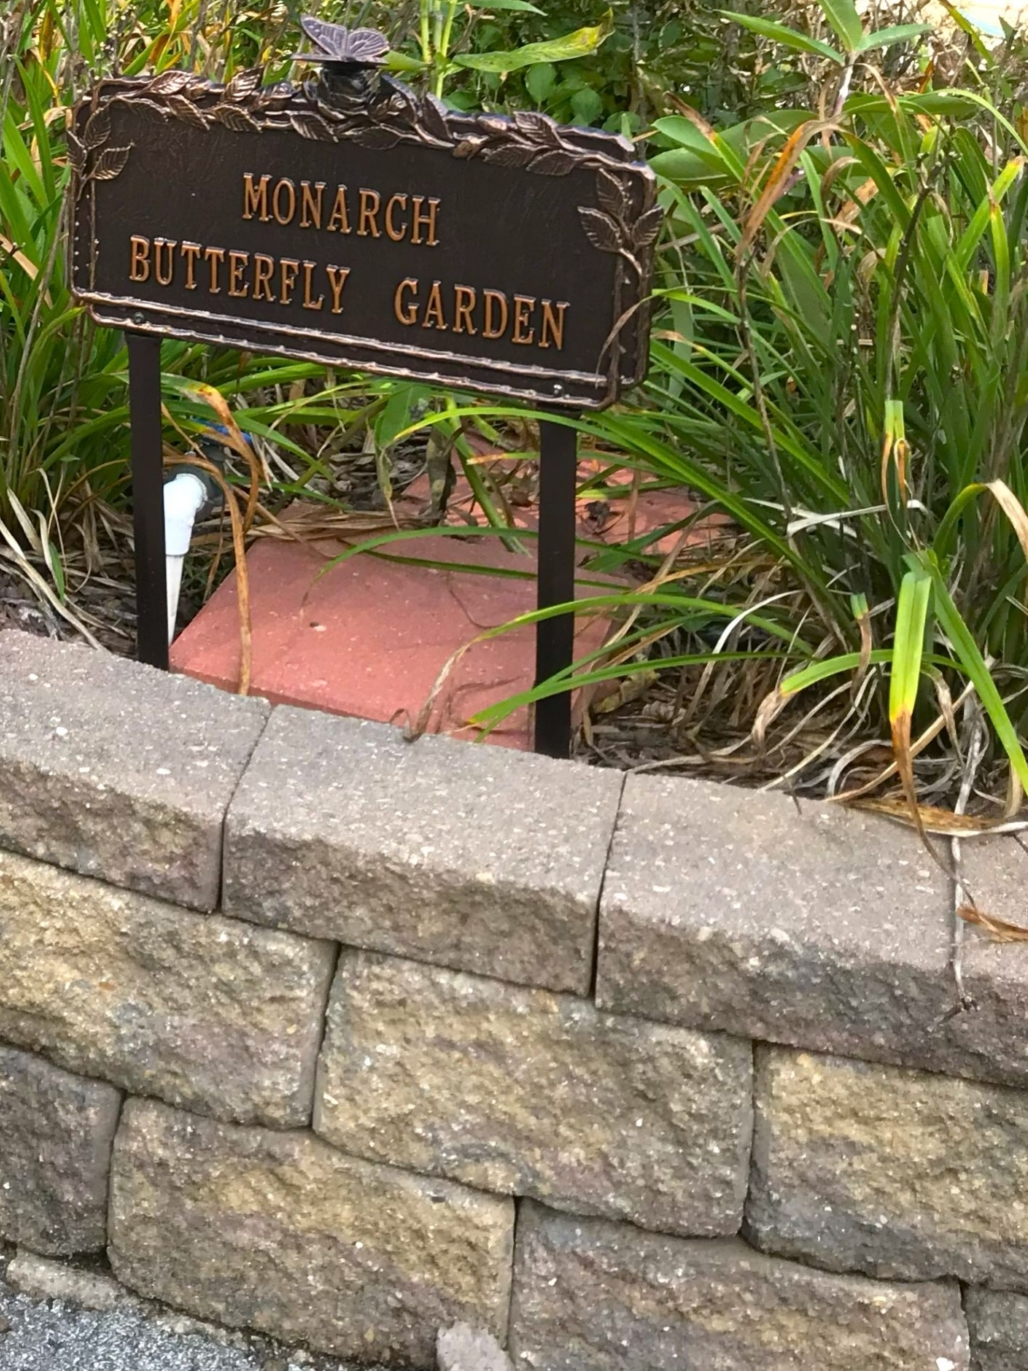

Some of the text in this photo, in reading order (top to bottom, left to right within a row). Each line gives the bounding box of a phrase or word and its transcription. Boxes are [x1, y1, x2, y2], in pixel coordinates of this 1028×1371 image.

[242, 172, 441, 247] MONARCH
[129, 234, 571, 350] BUTTERFLY GARDEN
